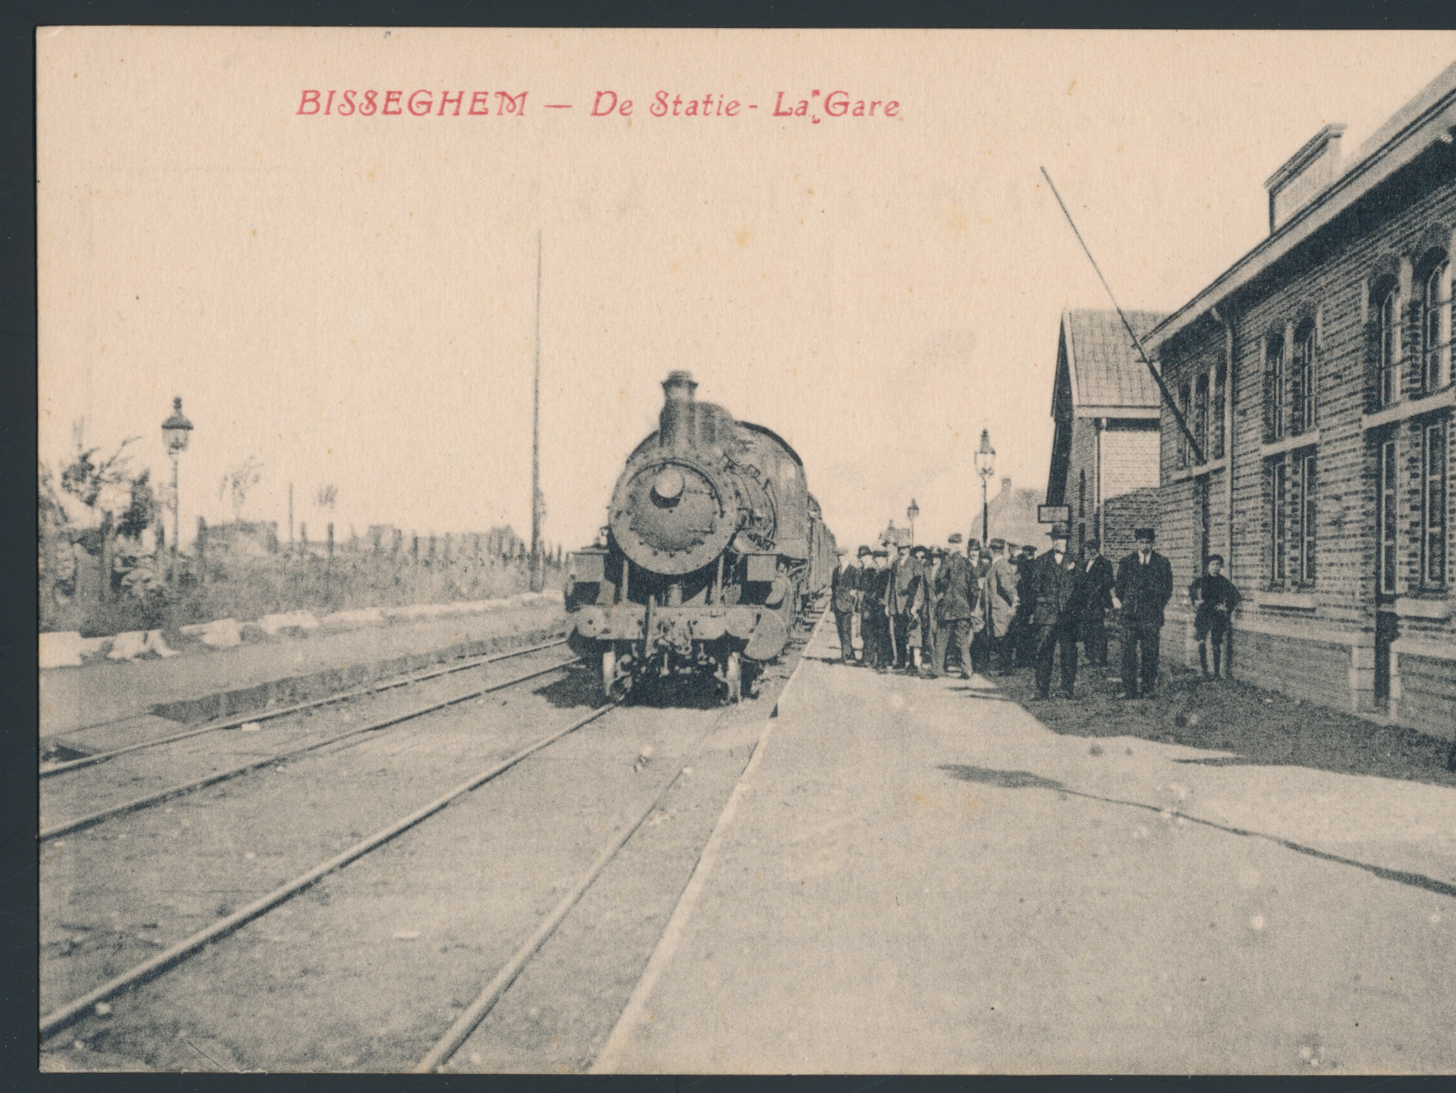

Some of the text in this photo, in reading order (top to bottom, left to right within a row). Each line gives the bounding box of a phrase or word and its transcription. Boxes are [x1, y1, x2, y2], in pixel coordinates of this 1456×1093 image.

[295, 88, 529, 117] BISSEGHEM
[589, 90, 634, 117] De
[649, 89, 741, 118] Statie
[823, 89, 901, 118] Gare
